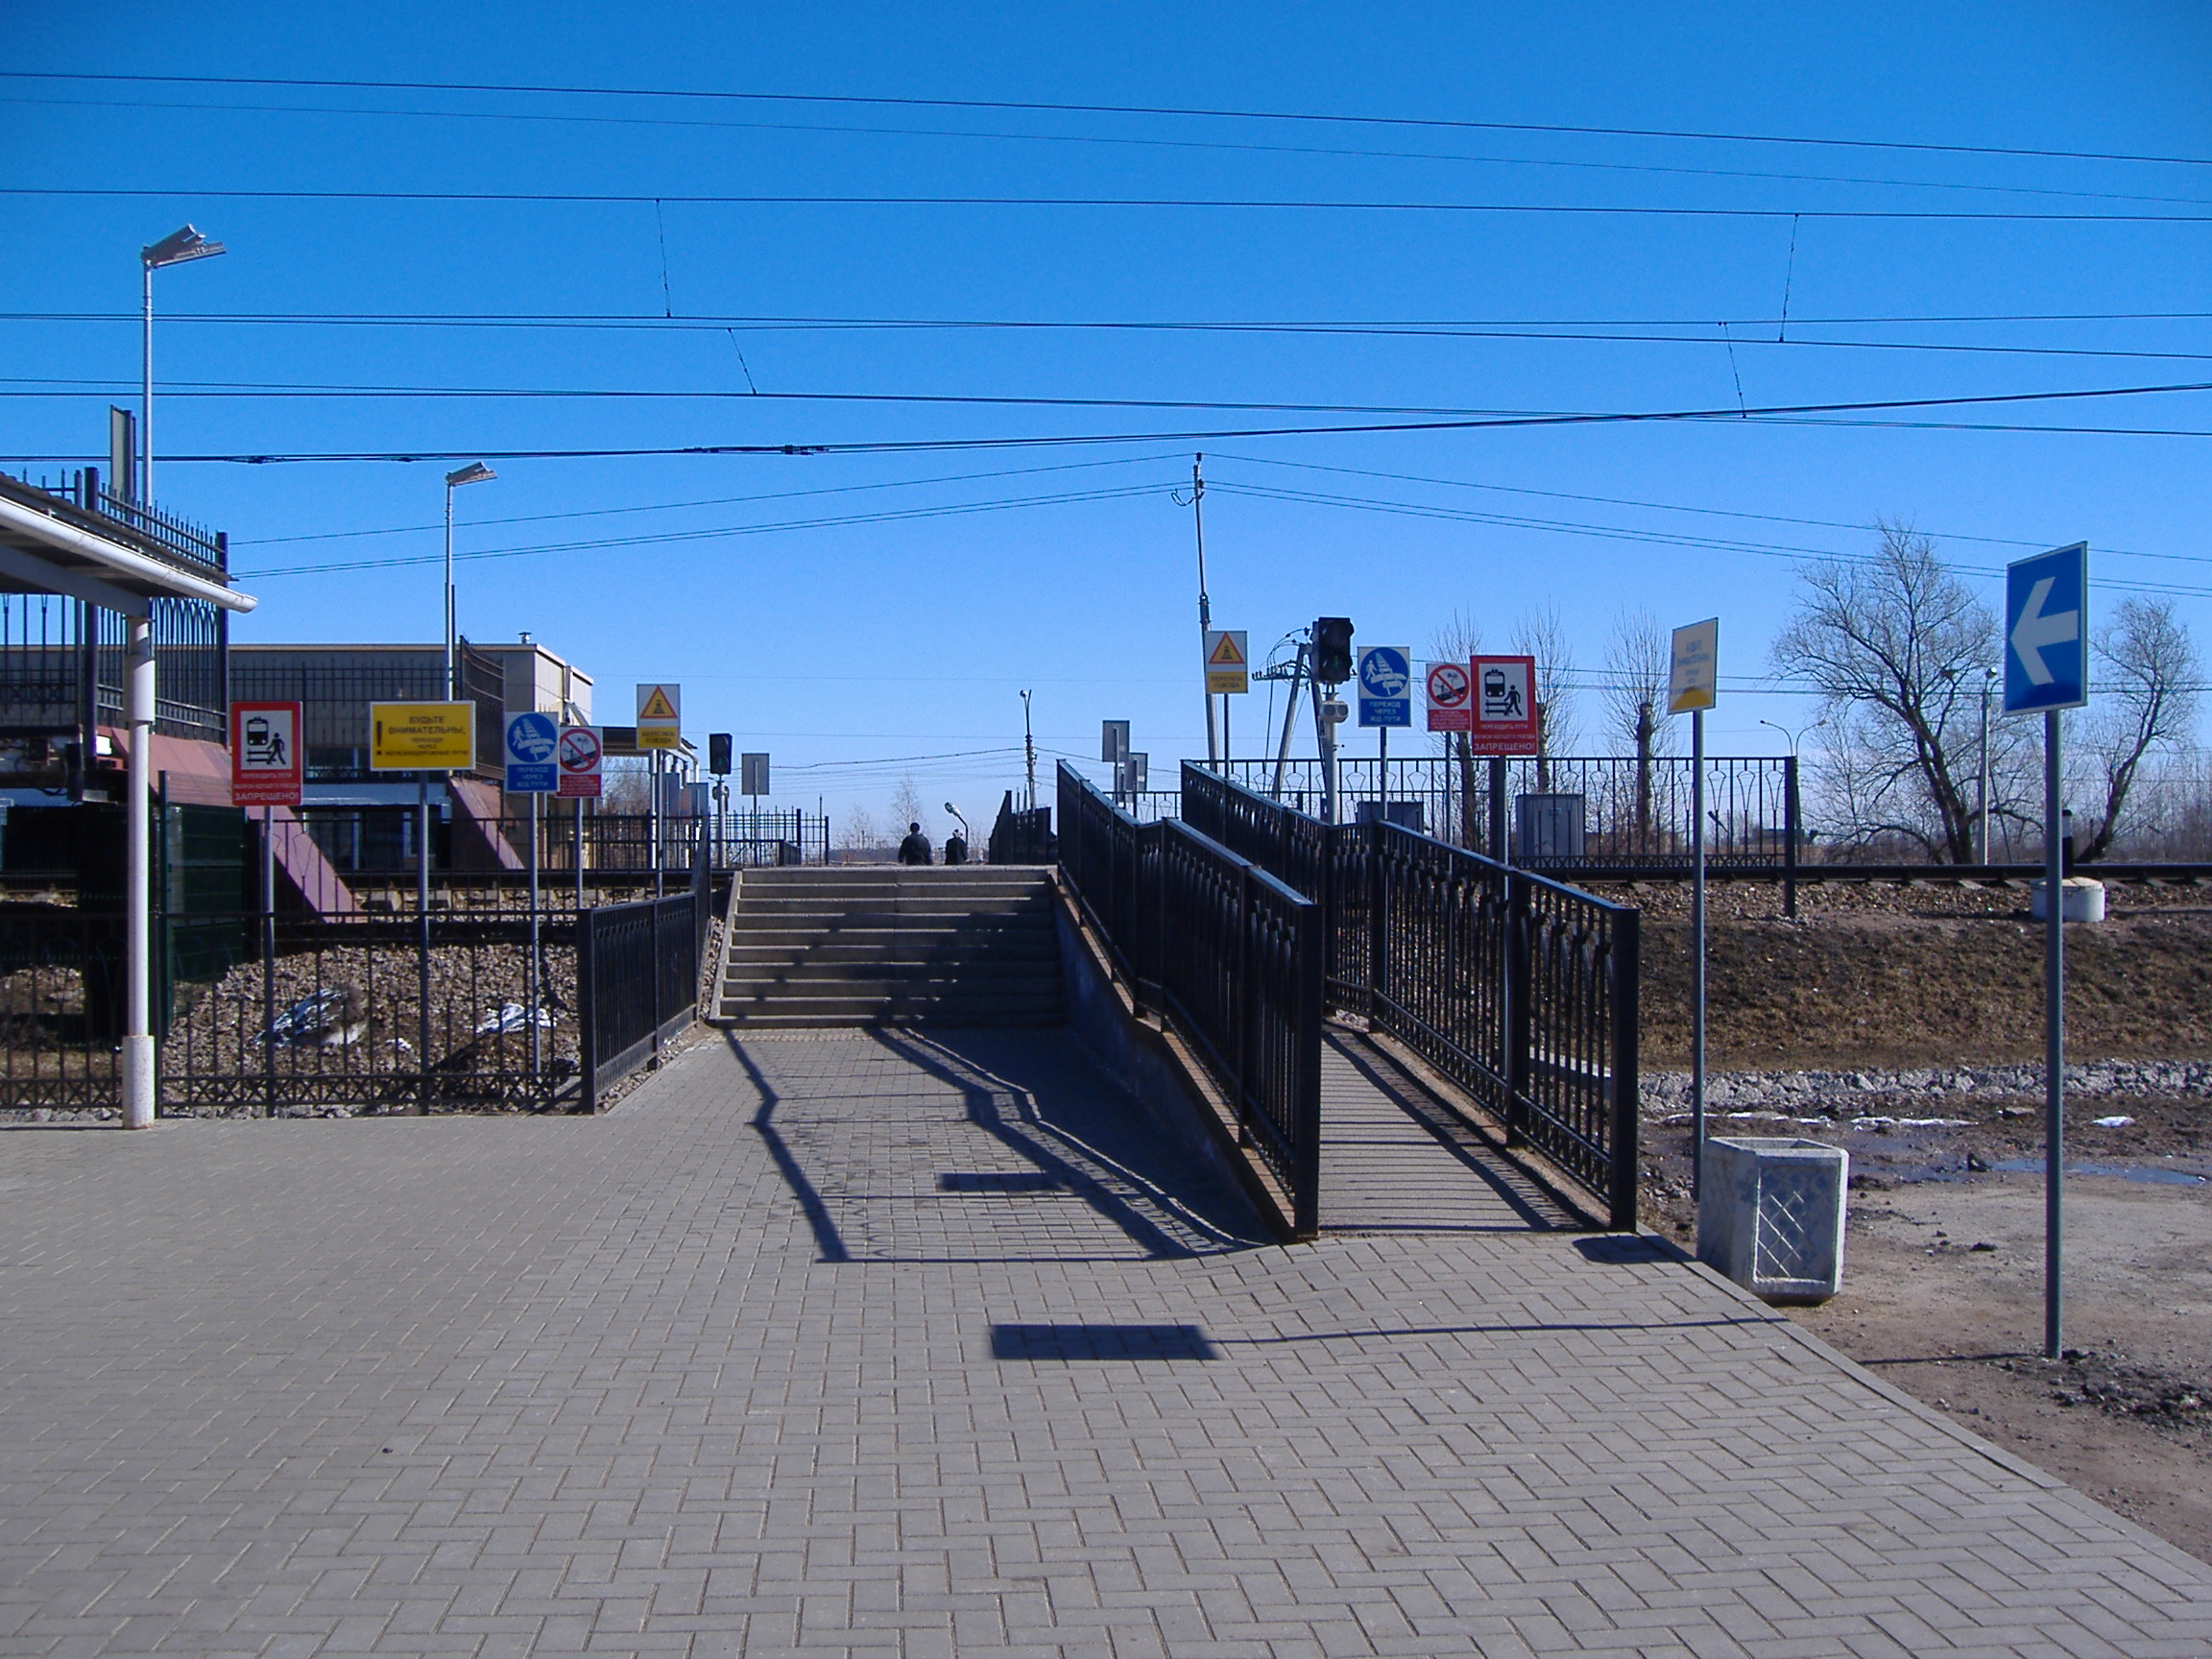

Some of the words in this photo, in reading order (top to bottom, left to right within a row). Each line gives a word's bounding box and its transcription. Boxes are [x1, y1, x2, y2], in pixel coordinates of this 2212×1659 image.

[388, 726, 467, 734] ВНИМАТЕЛЬНЫ,
[1474, 742, 1535, 751] ЗАПРЕЩЕНО!
[235, 792, 299, 801] ЗАПРЕЩЕНО!
